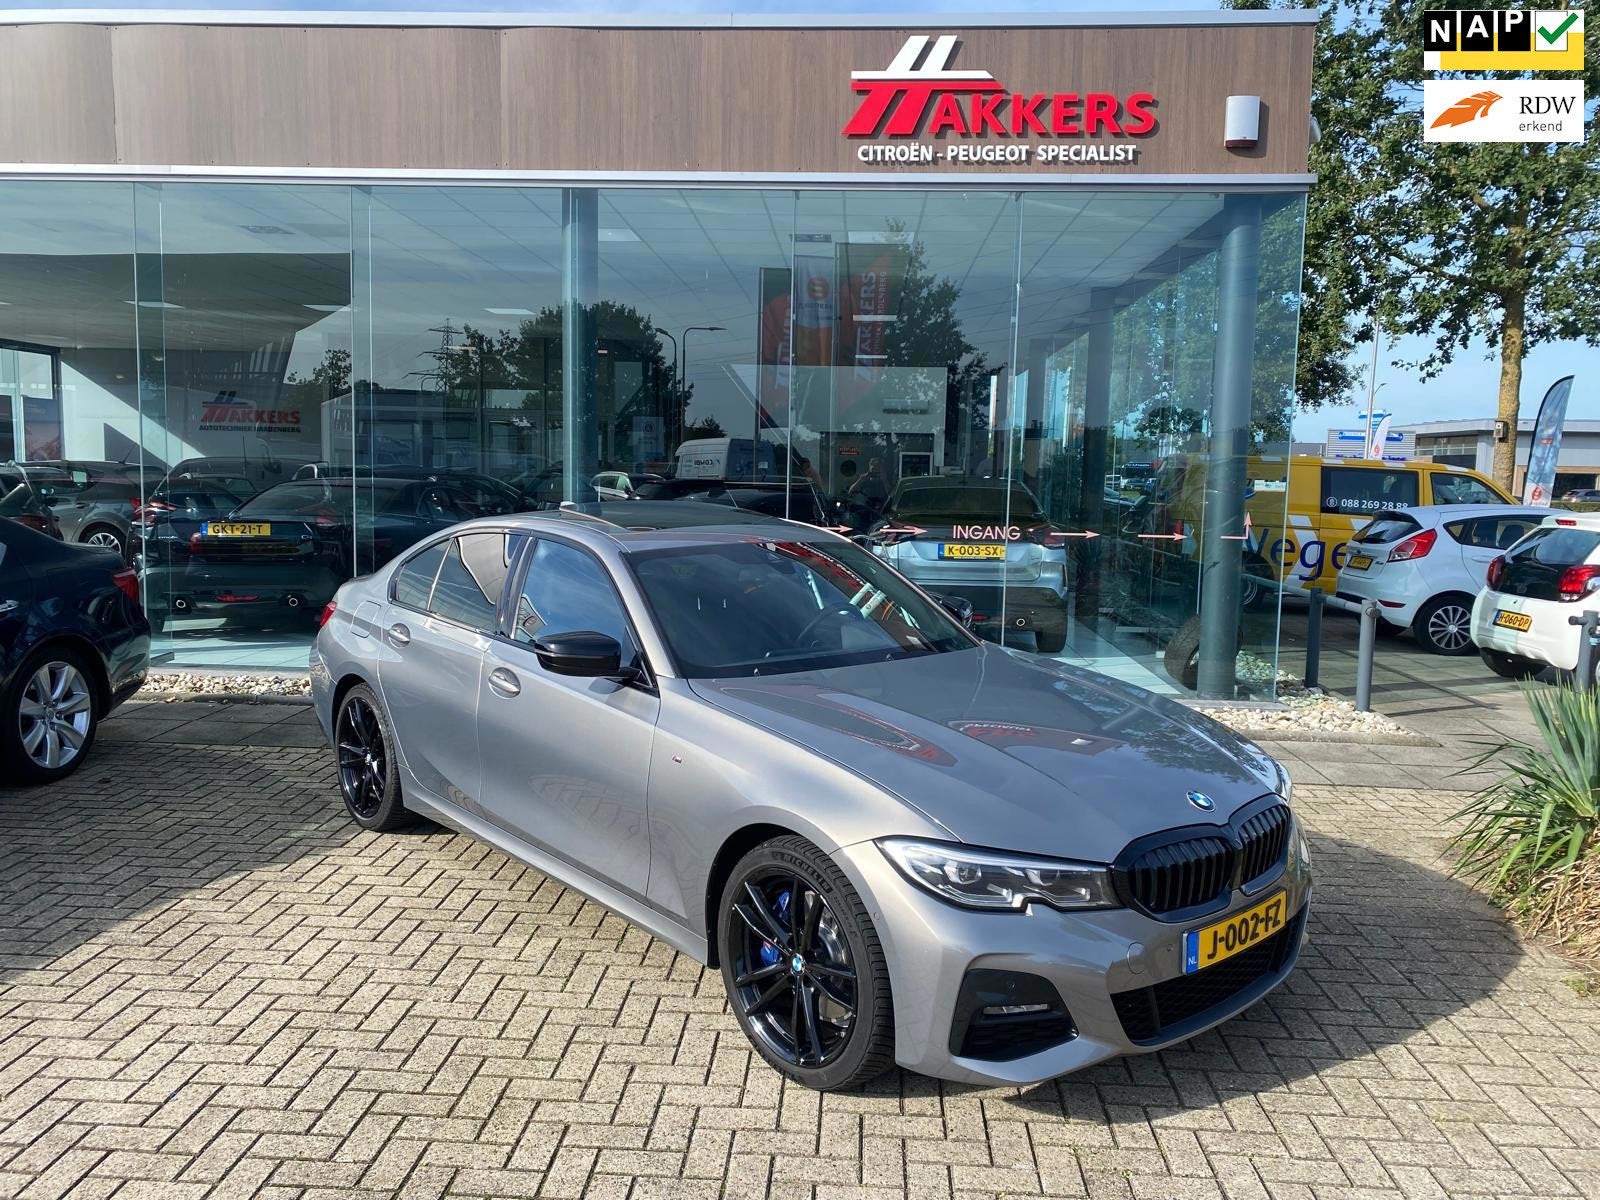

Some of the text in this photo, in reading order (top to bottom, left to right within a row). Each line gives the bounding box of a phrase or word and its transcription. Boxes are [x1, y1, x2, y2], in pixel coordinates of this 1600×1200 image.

[841, 35, 1156, 136] HAKKERS
[857, 142, 932, 161] CITROËN
[947, 145, 1028, 161] PEUGEOT
[1037, 144, 1137, 161] SPECIALIST
[1341, 498, 1359, 508] 088
[1362, 500, 1379, 510] 269
[1382, 502, 1393, 510] 28
[212, 524, 264, 534] GKT-21-T
[953, 524, 1021, 540] INGANG
[948, 545, 998, 556] K-003-SX
[1207, 898, 1282, 960] J-002-FZ
[1188, 957, 1197, 966] NL
